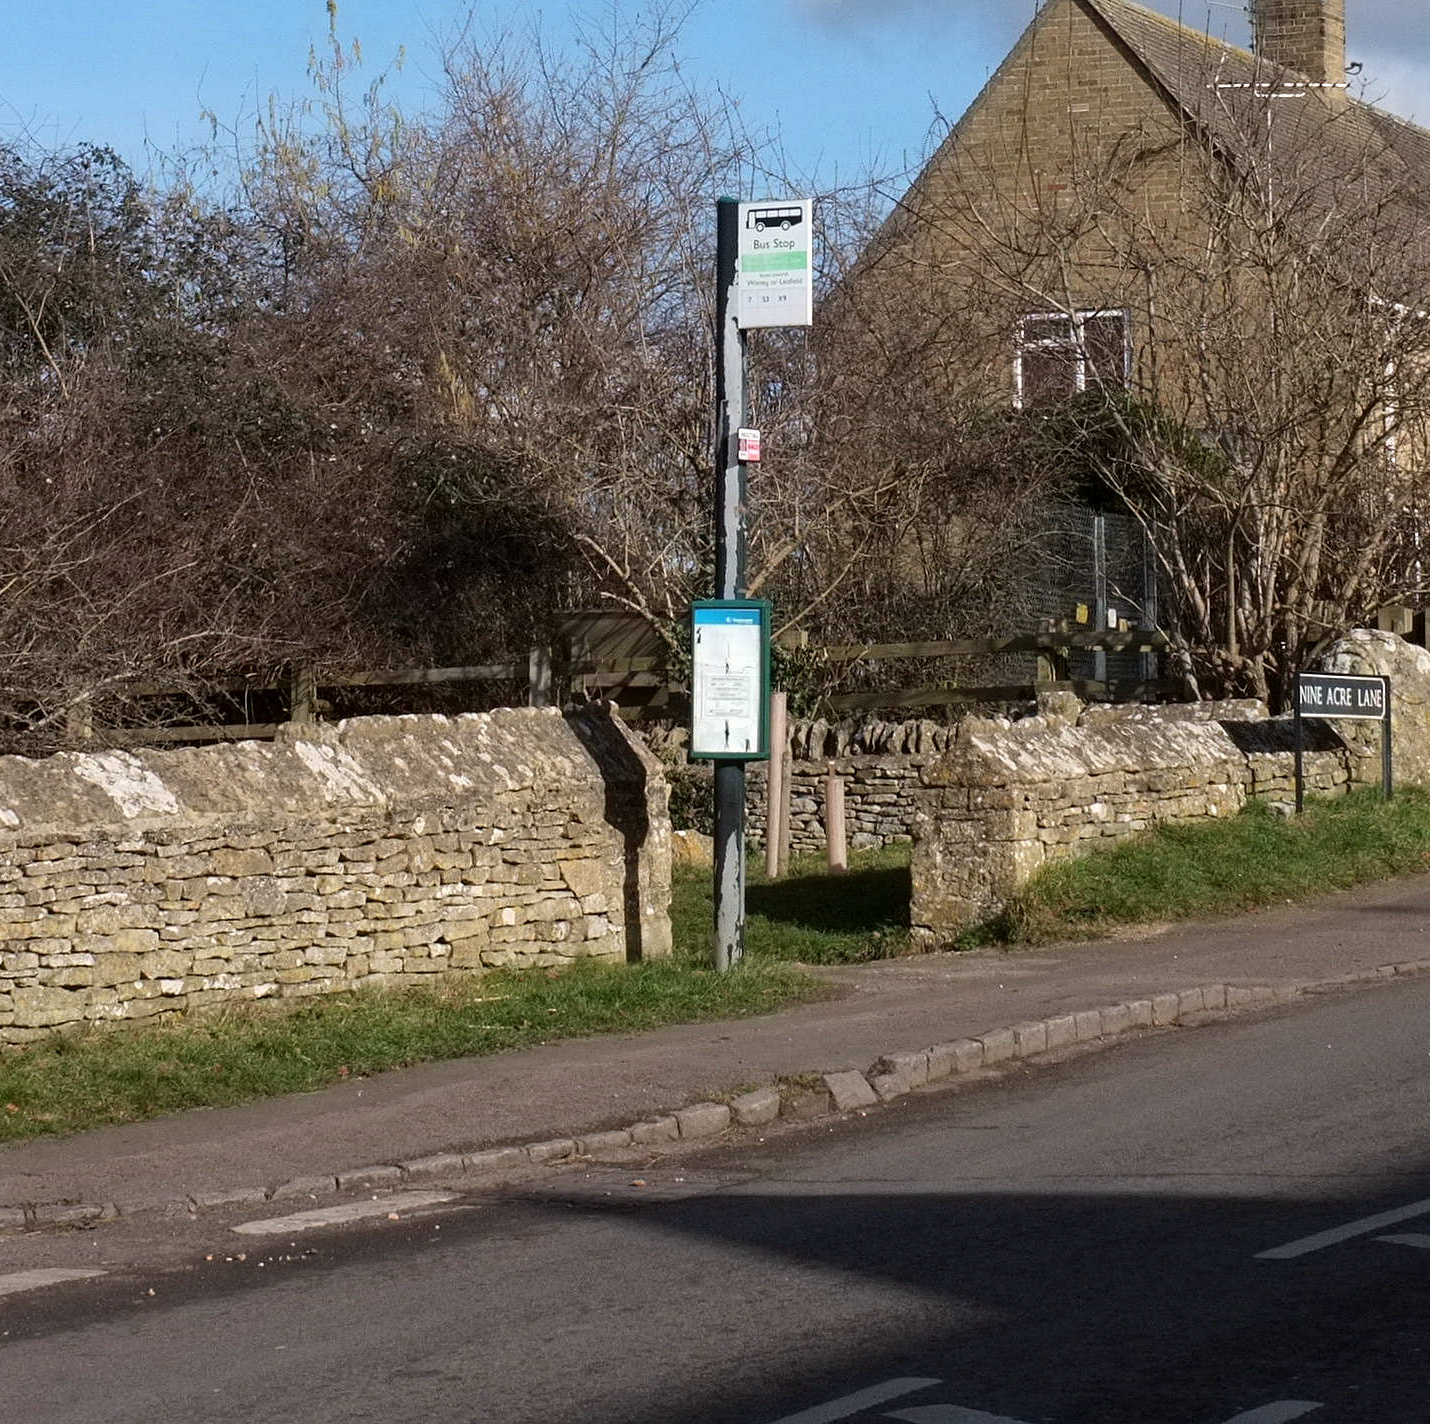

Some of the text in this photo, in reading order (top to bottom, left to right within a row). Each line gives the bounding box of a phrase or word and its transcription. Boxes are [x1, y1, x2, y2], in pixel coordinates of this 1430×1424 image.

[753, 238, 796, 251] Bus Stop
[1299, 685, 1382, 708] NINE ACRE LANE
